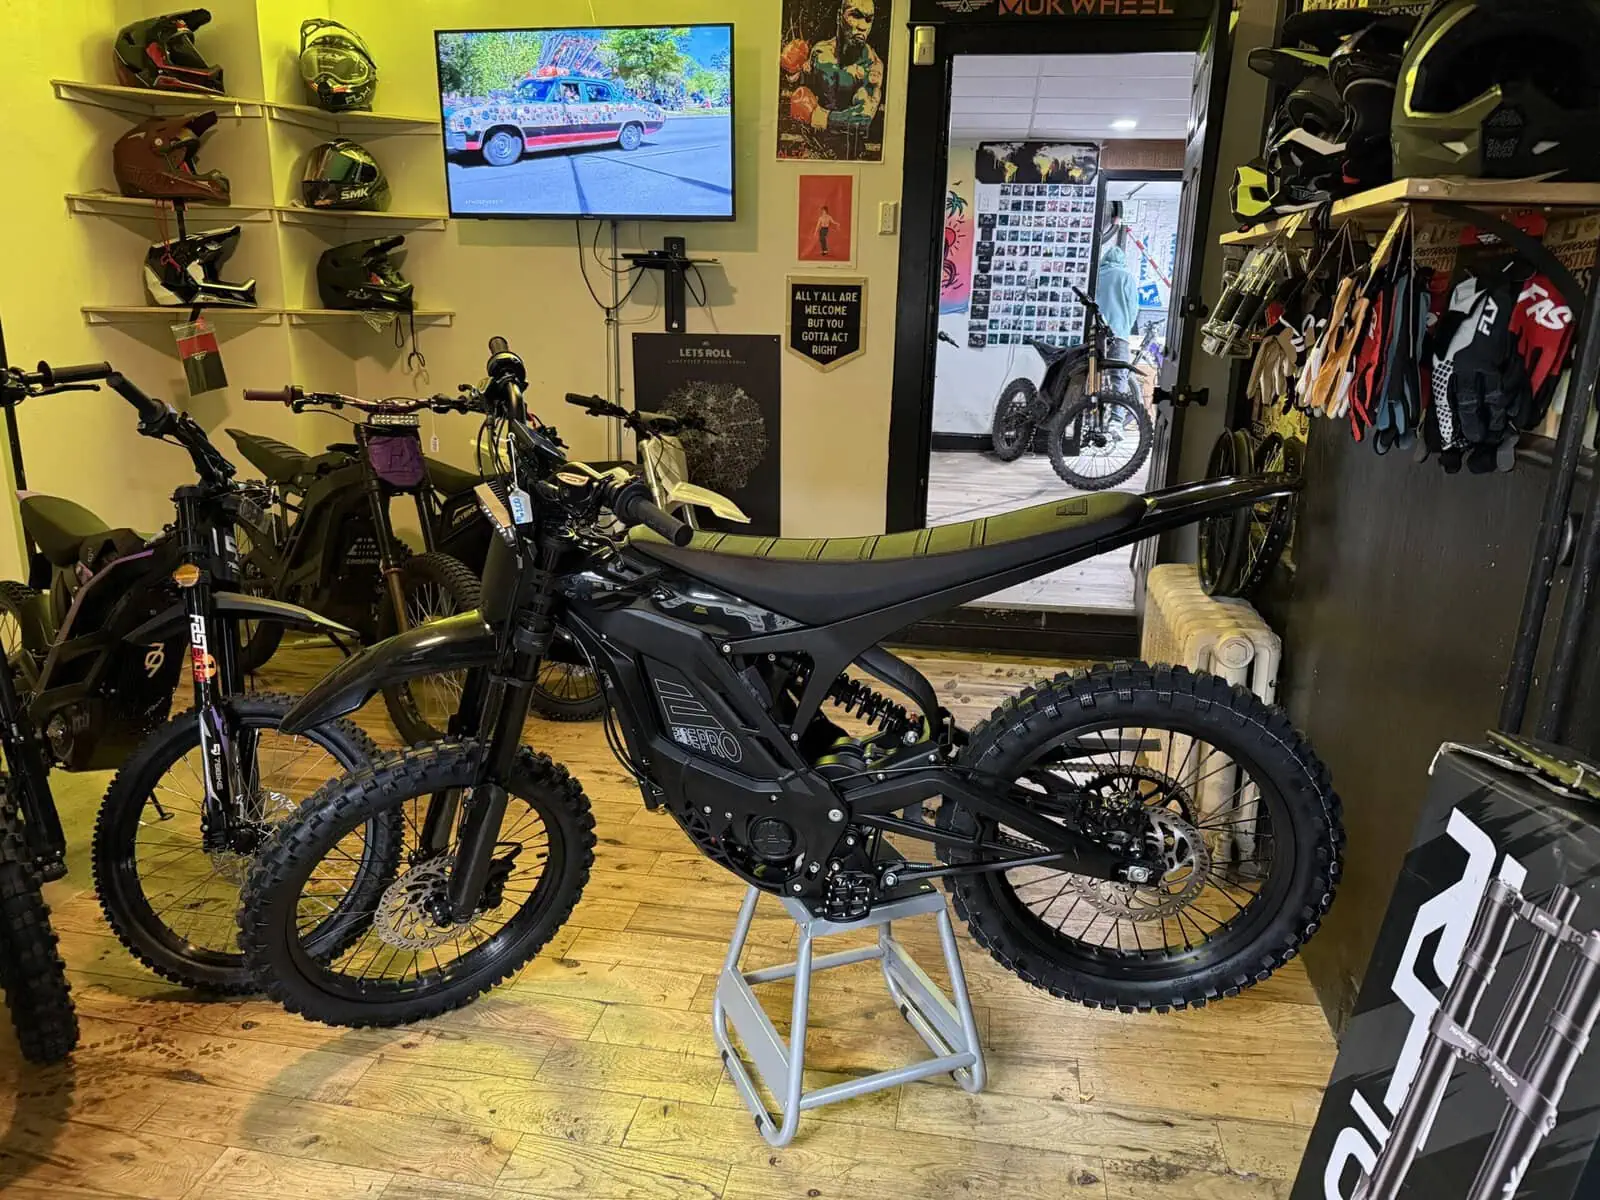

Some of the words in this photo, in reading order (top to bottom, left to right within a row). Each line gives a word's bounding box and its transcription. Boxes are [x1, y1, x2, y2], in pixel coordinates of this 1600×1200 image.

[341, 187, 369, 200] SMK
[795, 291, 811, 301] ALL
[839, 292, 858, 302] ARE
[804, 304, 847, 316] WELCOME
[1478, 295, 1499, 336] FLY
[807, 318, 824, 328] BUT
[826, 318, 844, 328] YOU
[801, 331, 829, 342] GOTTA
[831, 332, 849, 342] ACT
[679, 348, 704, 358] LETS
[705, 348, 732, 358] ROLL
[811, 344, 838, 356] RIGHT
